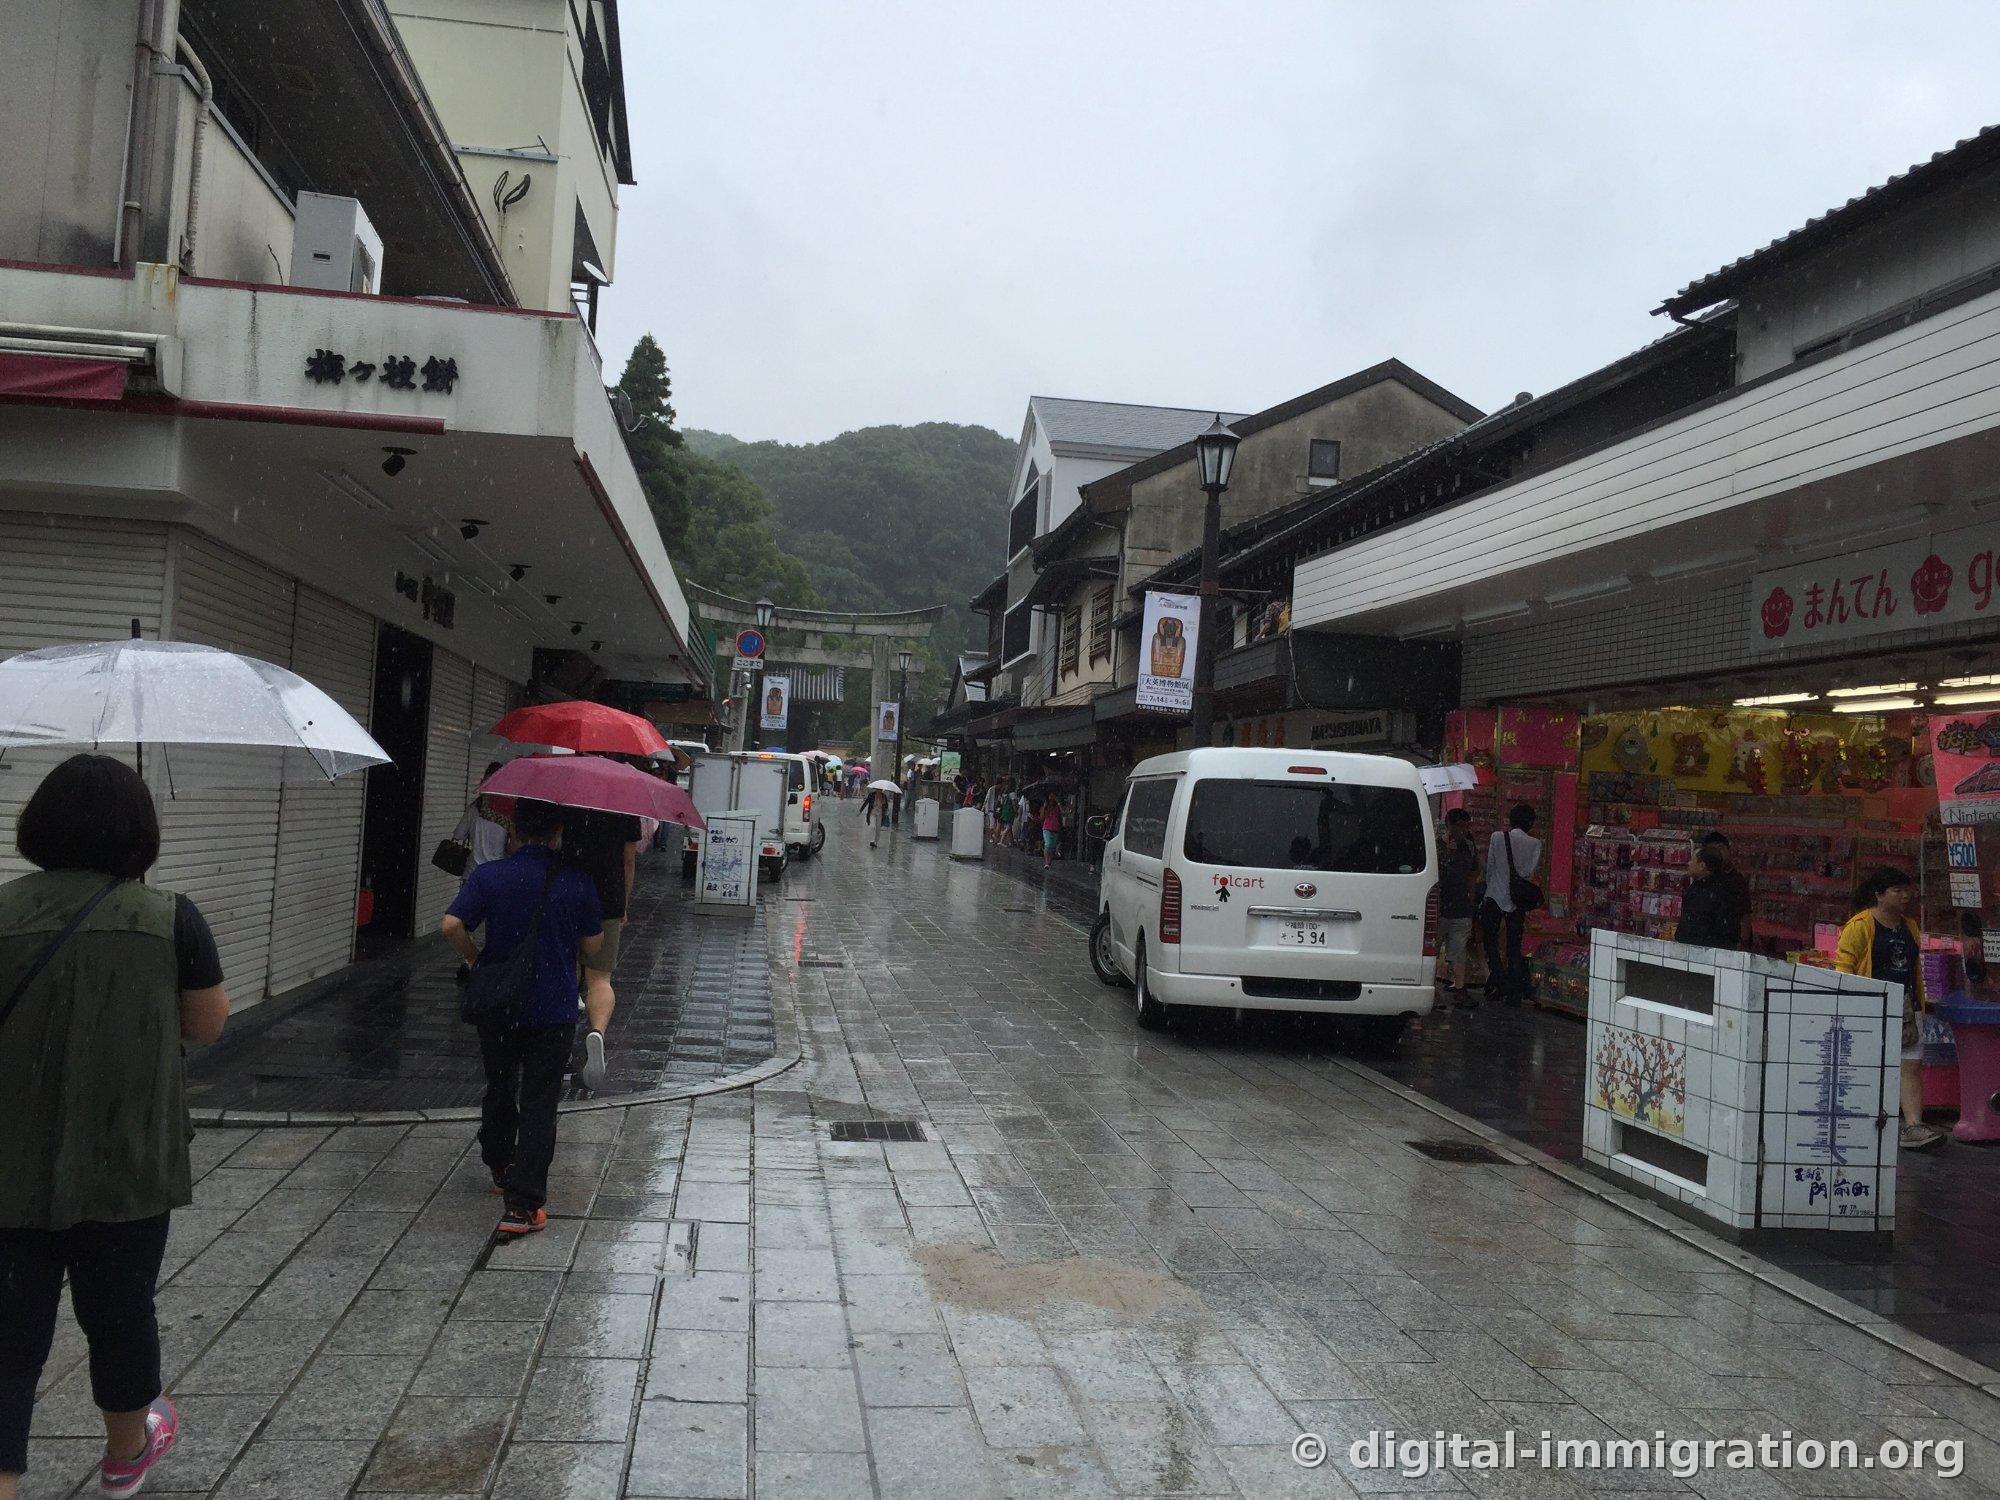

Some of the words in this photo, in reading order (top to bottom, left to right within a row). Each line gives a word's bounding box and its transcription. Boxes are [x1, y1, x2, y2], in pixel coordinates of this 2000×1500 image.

[1804, 568, 1898, 629] まんてん
[736, 659, 762, 668] ここまで
[1948, 843, 1975, 866] ¥500
